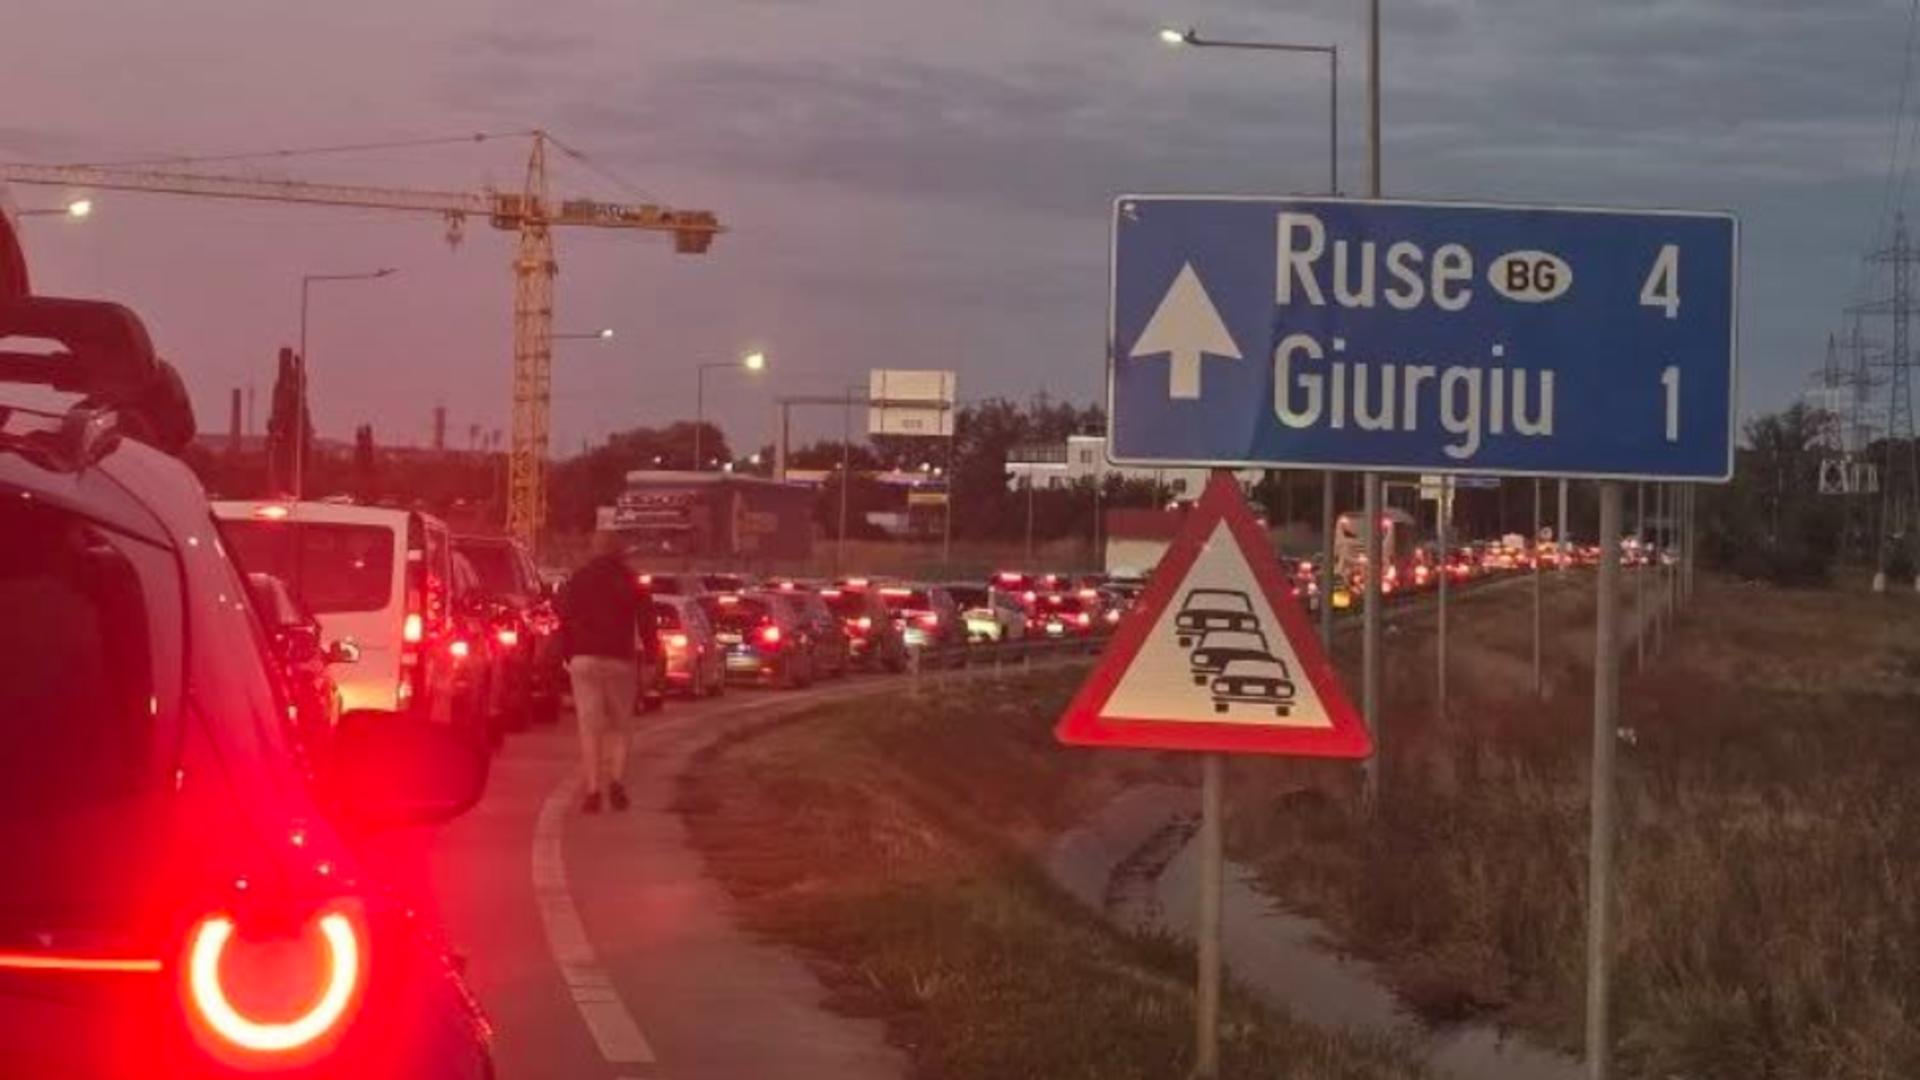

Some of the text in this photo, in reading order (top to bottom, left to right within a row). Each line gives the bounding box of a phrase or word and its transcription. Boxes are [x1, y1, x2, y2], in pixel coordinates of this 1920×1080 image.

[1275, 213, 1680, 318] Ruse BG 4
[1274, 334, 1679, 459] Giurgiu 1
